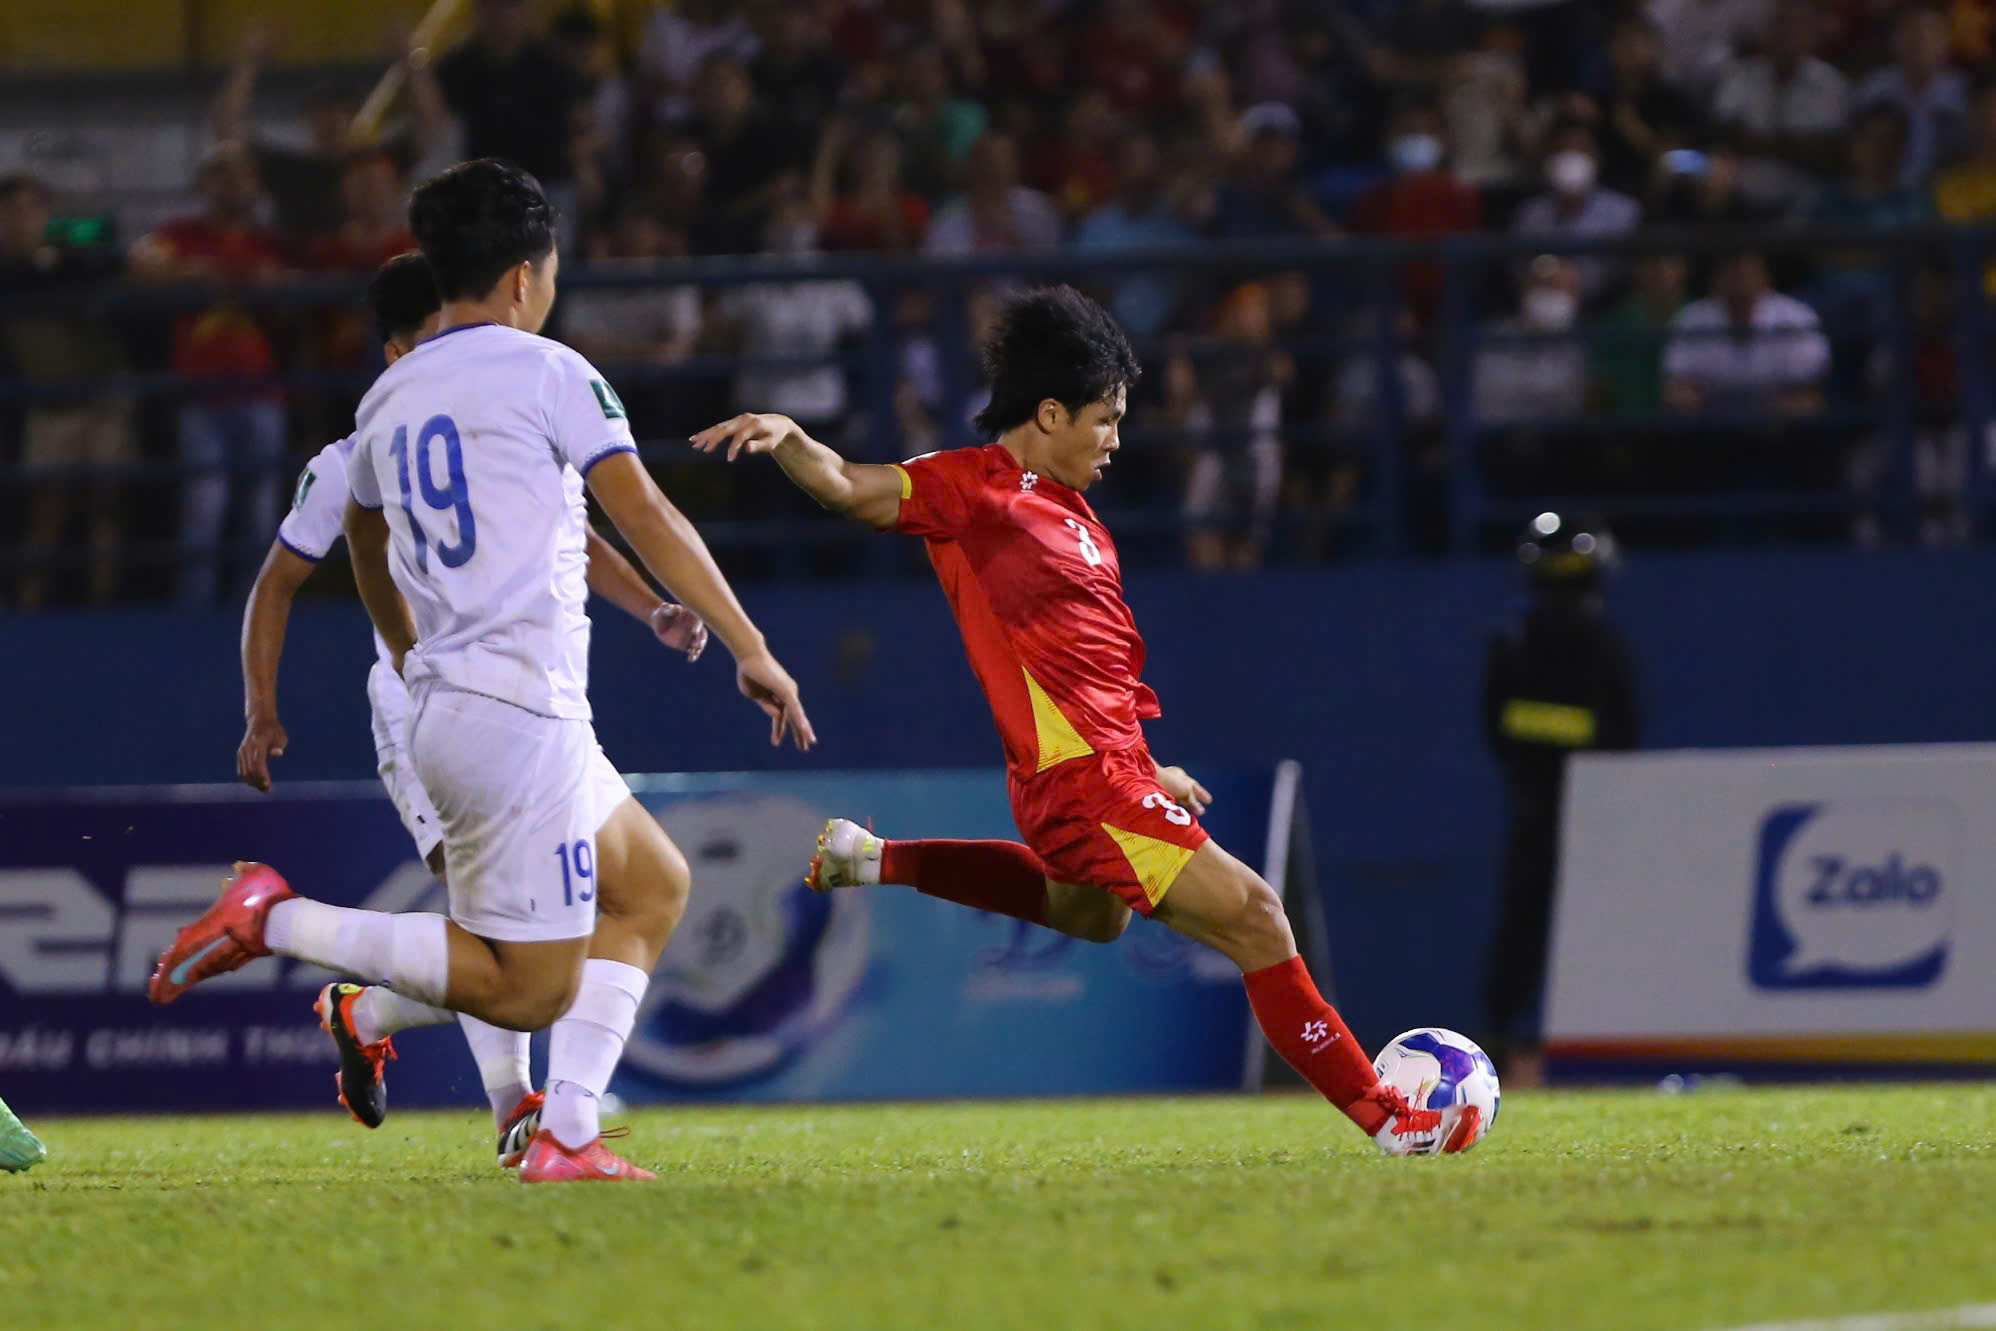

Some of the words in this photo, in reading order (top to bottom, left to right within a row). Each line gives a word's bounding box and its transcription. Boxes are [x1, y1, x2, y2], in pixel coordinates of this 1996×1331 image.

[388, 414, 476, 575] 19
[1142, 791, 1192, 827] 3
[553, 838, 594, 907] 19
[1804, 853, 1943, 908] Zalo
